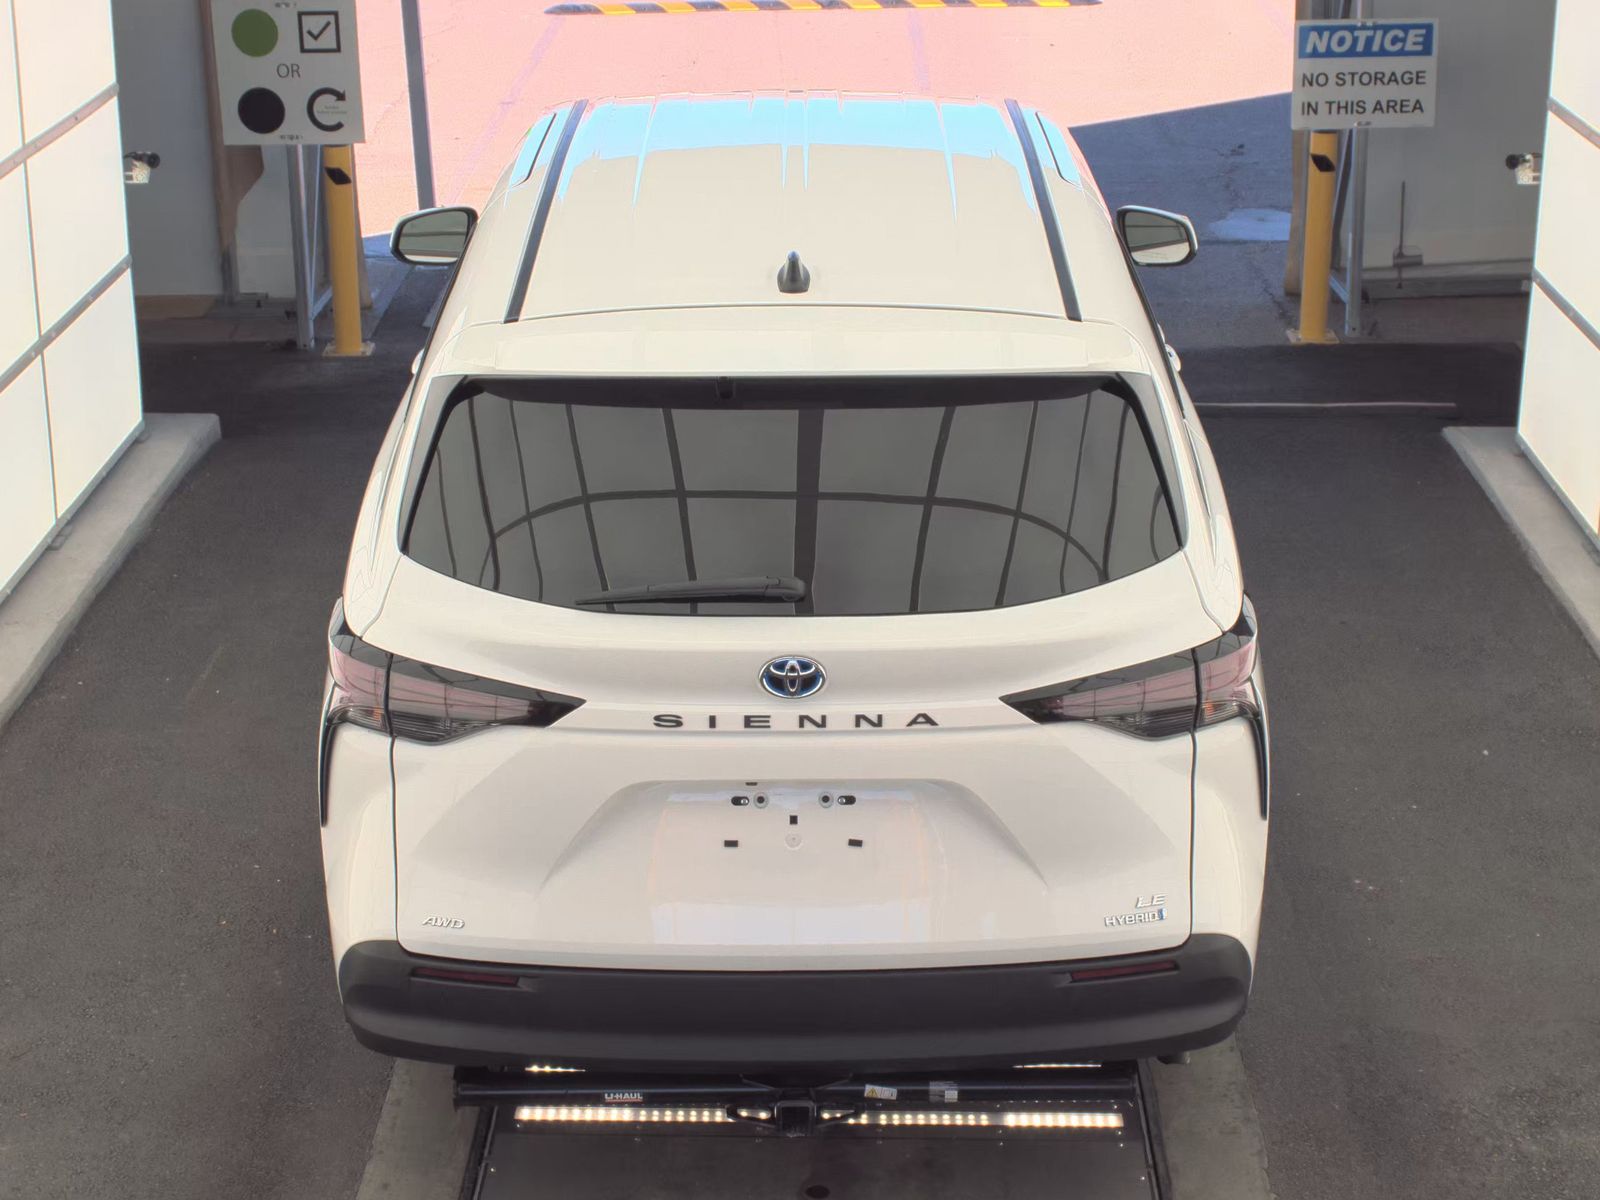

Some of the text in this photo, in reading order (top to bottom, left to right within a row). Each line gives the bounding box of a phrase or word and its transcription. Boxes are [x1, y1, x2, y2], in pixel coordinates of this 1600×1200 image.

[1305, 29, 1427, 53] NOTICE
[276, 63, 301, 78] OR
[1302, 70, 1427, 87] NO STORAGE
[1301, 99, 1424, 115] IN THIS AREA
[653, 713, 939, 728] SIENNA
[1135, 894, 1166, 908] LE
[422, 916, 466, 929] AWD
[1104, 911, 1158, 927] HYBRID
